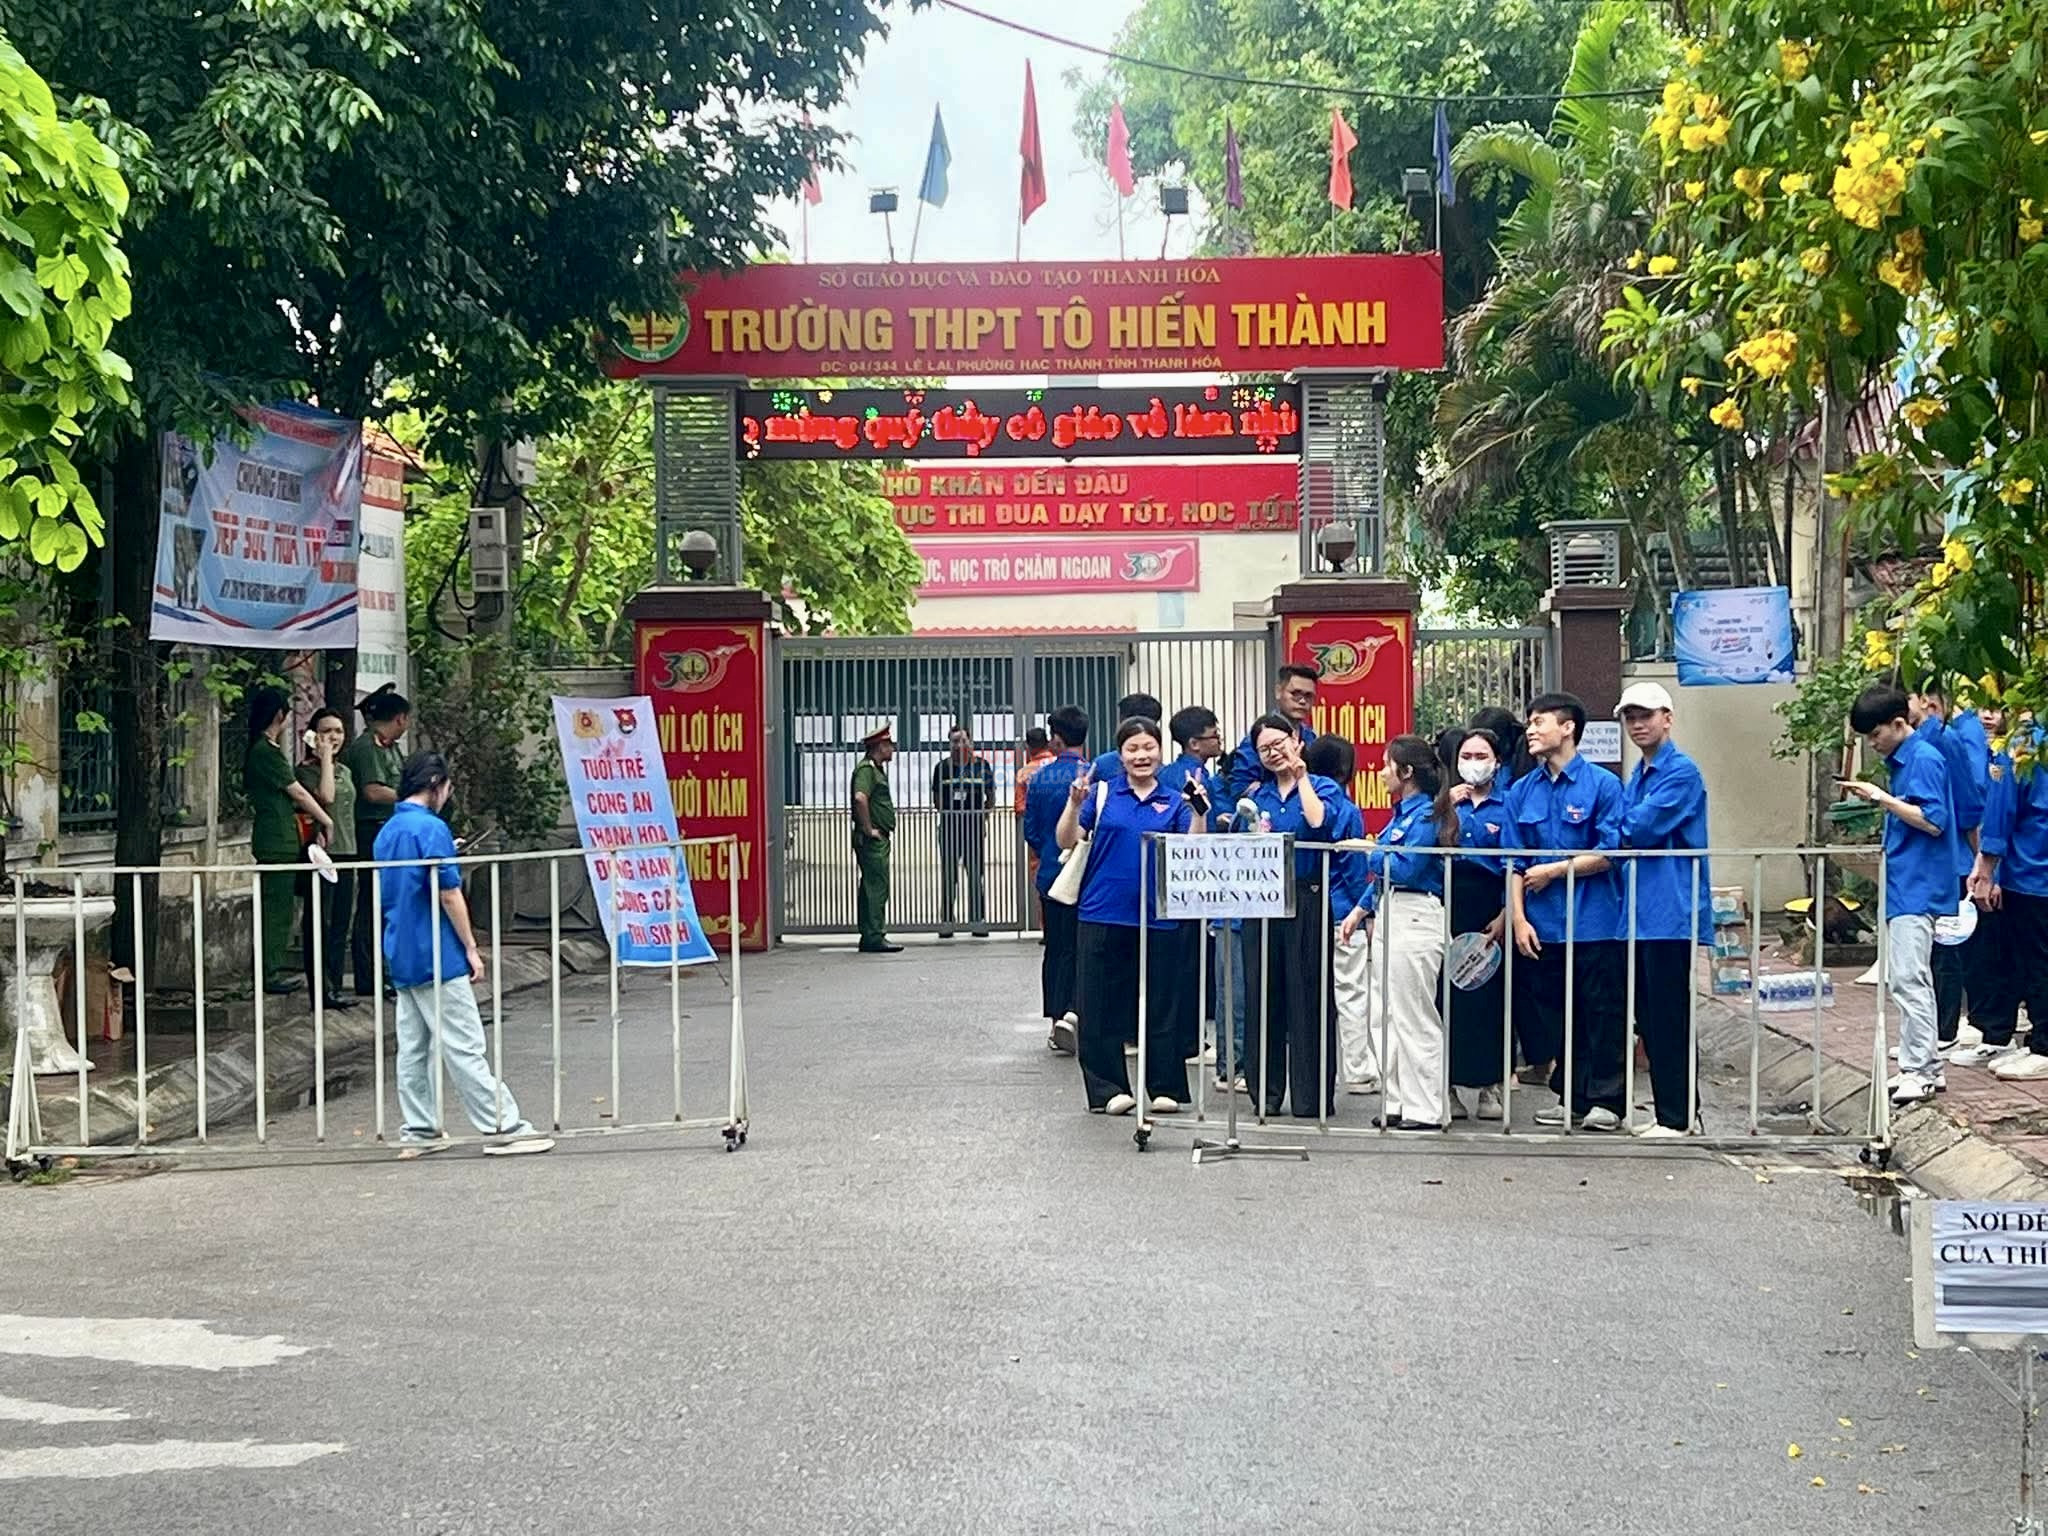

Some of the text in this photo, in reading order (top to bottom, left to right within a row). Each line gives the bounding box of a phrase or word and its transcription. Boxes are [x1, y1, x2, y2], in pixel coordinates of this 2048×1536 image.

[910, 270, 951, 291] DỤC
[1040, 269, 1082, 289] TẠO
[1089, 268, 1169, 285] THANH
[703, 290, 1387, 353] TRƯỜNG THPT TÔ HIẾN THÀNH
[849, 360, 897, 373] 04/344
[904, 357, 925, 373] LÊ
[956, 357, 1015, 373] PHƯỜNG
[1054, 356, 1102, 371] THÀNH
[1140, 356, 1188, 370] THANH
[1006, 404, 1046, 441] cô
[1051, 404, 1122, 449] giáo
[1126, 397, 1168, 439] về
[930, 470, 1005, 496] KHĂN
[1013, 469, 1066, 496] ĐẾN
[894, 504, 936, 530] ỤC
[944, 503, 986, 525] THI
[995, 503, 1050, 525] ĐUA
[1058, 503, 1109, 529] DẠY
[1182, 501, 1236, 529] HỌC
[1246, 492, 1297, 523] TỐT
[949, 557, 980, 587] HỌC
[983, 553, 1010, 581] TRÒ
[1014, 553, 1057, 581] CHĂM
[1061, 556, 1112, 582] NGOAN
[658, 704, 743, 762] VÌ LỢI ÍCH
[1359, 696, 1386, 745] ÍCH
[632, 790, 653, 813] AN
[668, 769, 749, 818] ƯỜI NĂM
[717, 840, 752, 882] CY
[1171, 846, 1206, 860] KHU
[1250, 846, 1278, 859] THI
[1170, 866, 1231, 882] KHÔNG
[1962, 1210, 2009, 1232] NƠI
[1940, 1239, 2048, 1265] CỦA THÍ
